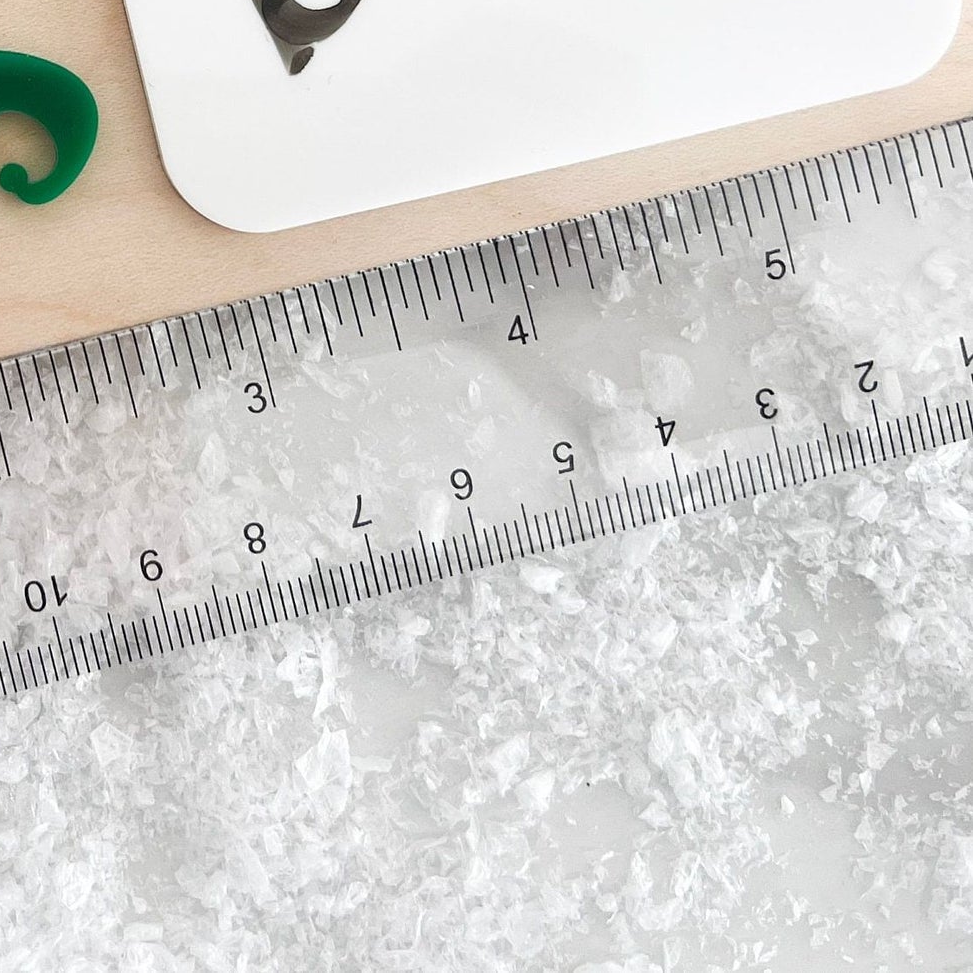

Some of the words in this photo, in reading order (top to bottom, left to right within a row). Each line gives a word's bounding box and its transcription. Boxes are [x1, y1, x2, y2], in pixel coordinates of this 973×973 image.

[243, 382, 268, 414] 3
[507, 314, 529, 345] 4
[764, 249, 787, 280] 5
[854, 360, 878, 392] 2
[755, 388, 778, 419] 3
[654, 416, 676, 447] 4
[552, 441, 575, 474] 5
[352, 494, 373, 528] 7
[243, 522, 267, 554] 8
[24, 575, 68, 612] 10
